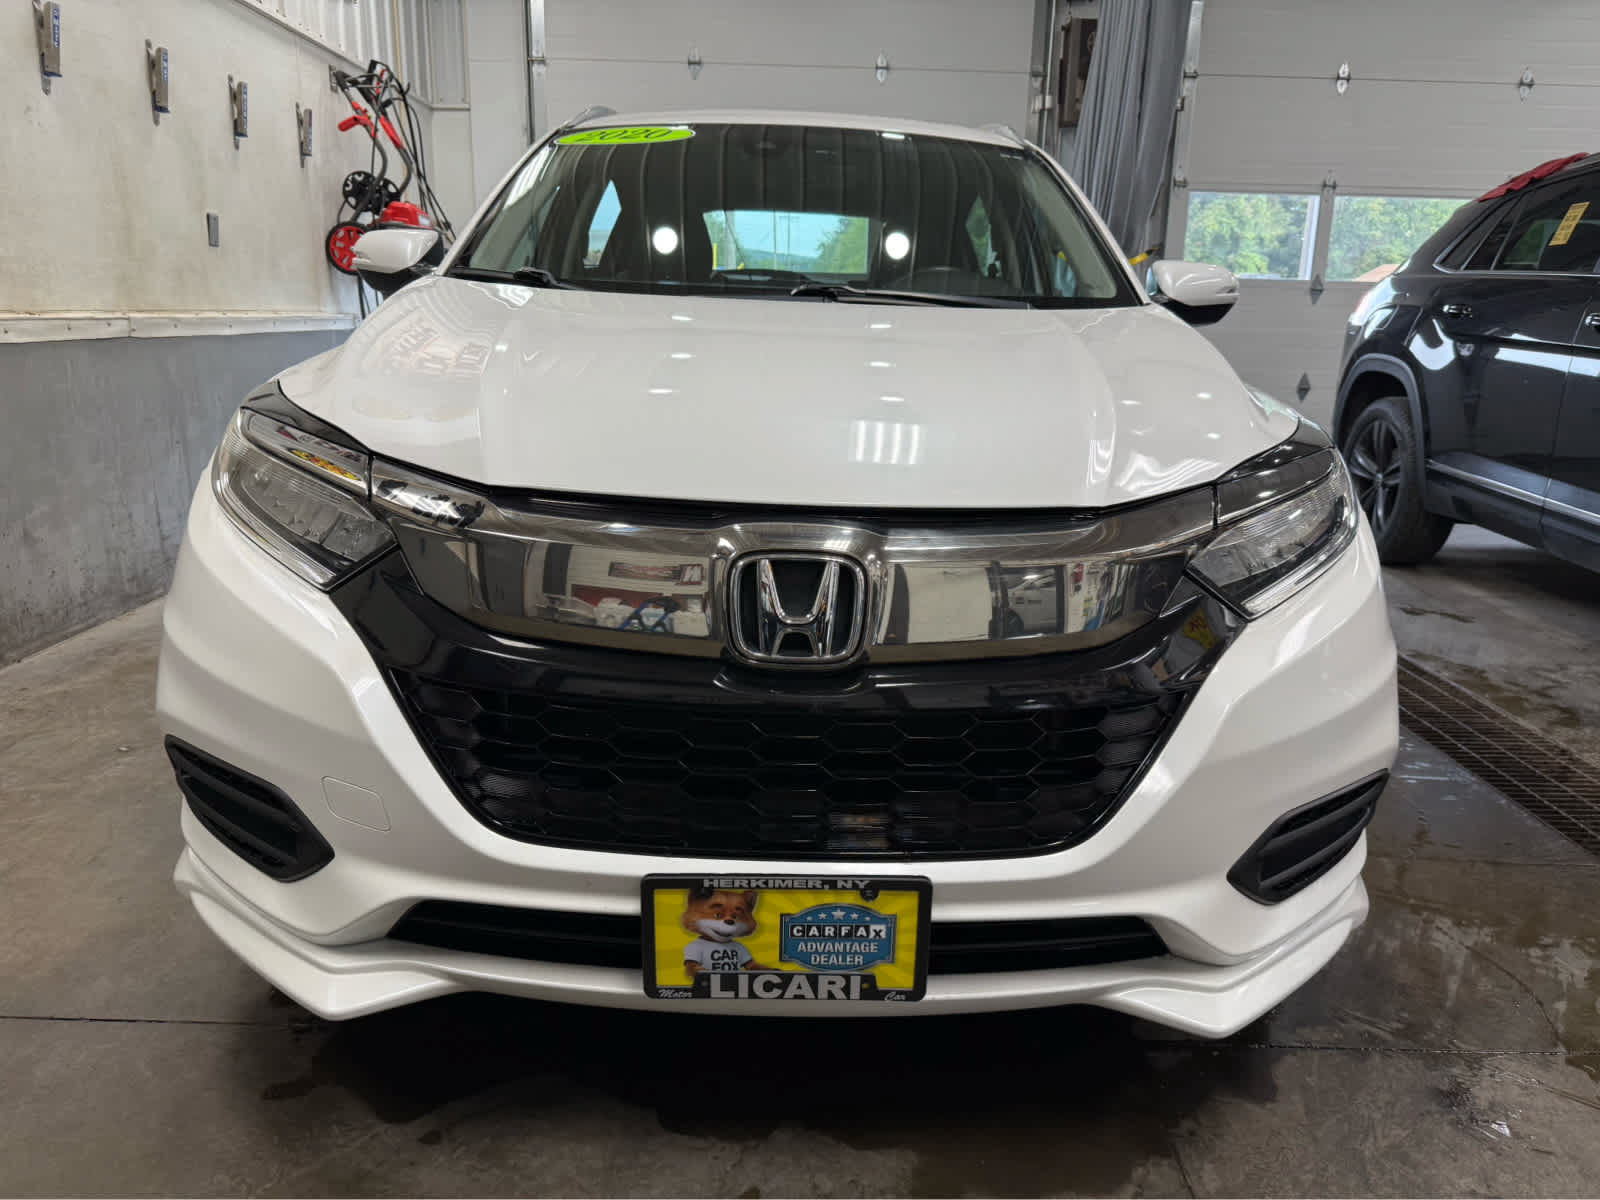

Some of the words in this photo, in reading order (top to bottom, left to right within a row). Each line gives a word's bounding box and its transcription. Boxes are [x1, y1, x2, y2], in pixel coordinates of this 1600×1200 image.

[575, 127, 673, 142] 2020
[703, 879, 830, 890] HERKIMER,
[837, 880, 869, 889] NY
[792, 926, 886, 938] CARFAX
[797, 942, 879, 953] ADVANTAGE
[710, 950, 738, 961] CAR
[811, 954, 864, 965] DEALER
[711, 962, 739, 971] FOX
[710, 974, 861, 1000] LICARI
[659, 989, 692, 998] Motor
[884, 991, 906, 1001] Car
